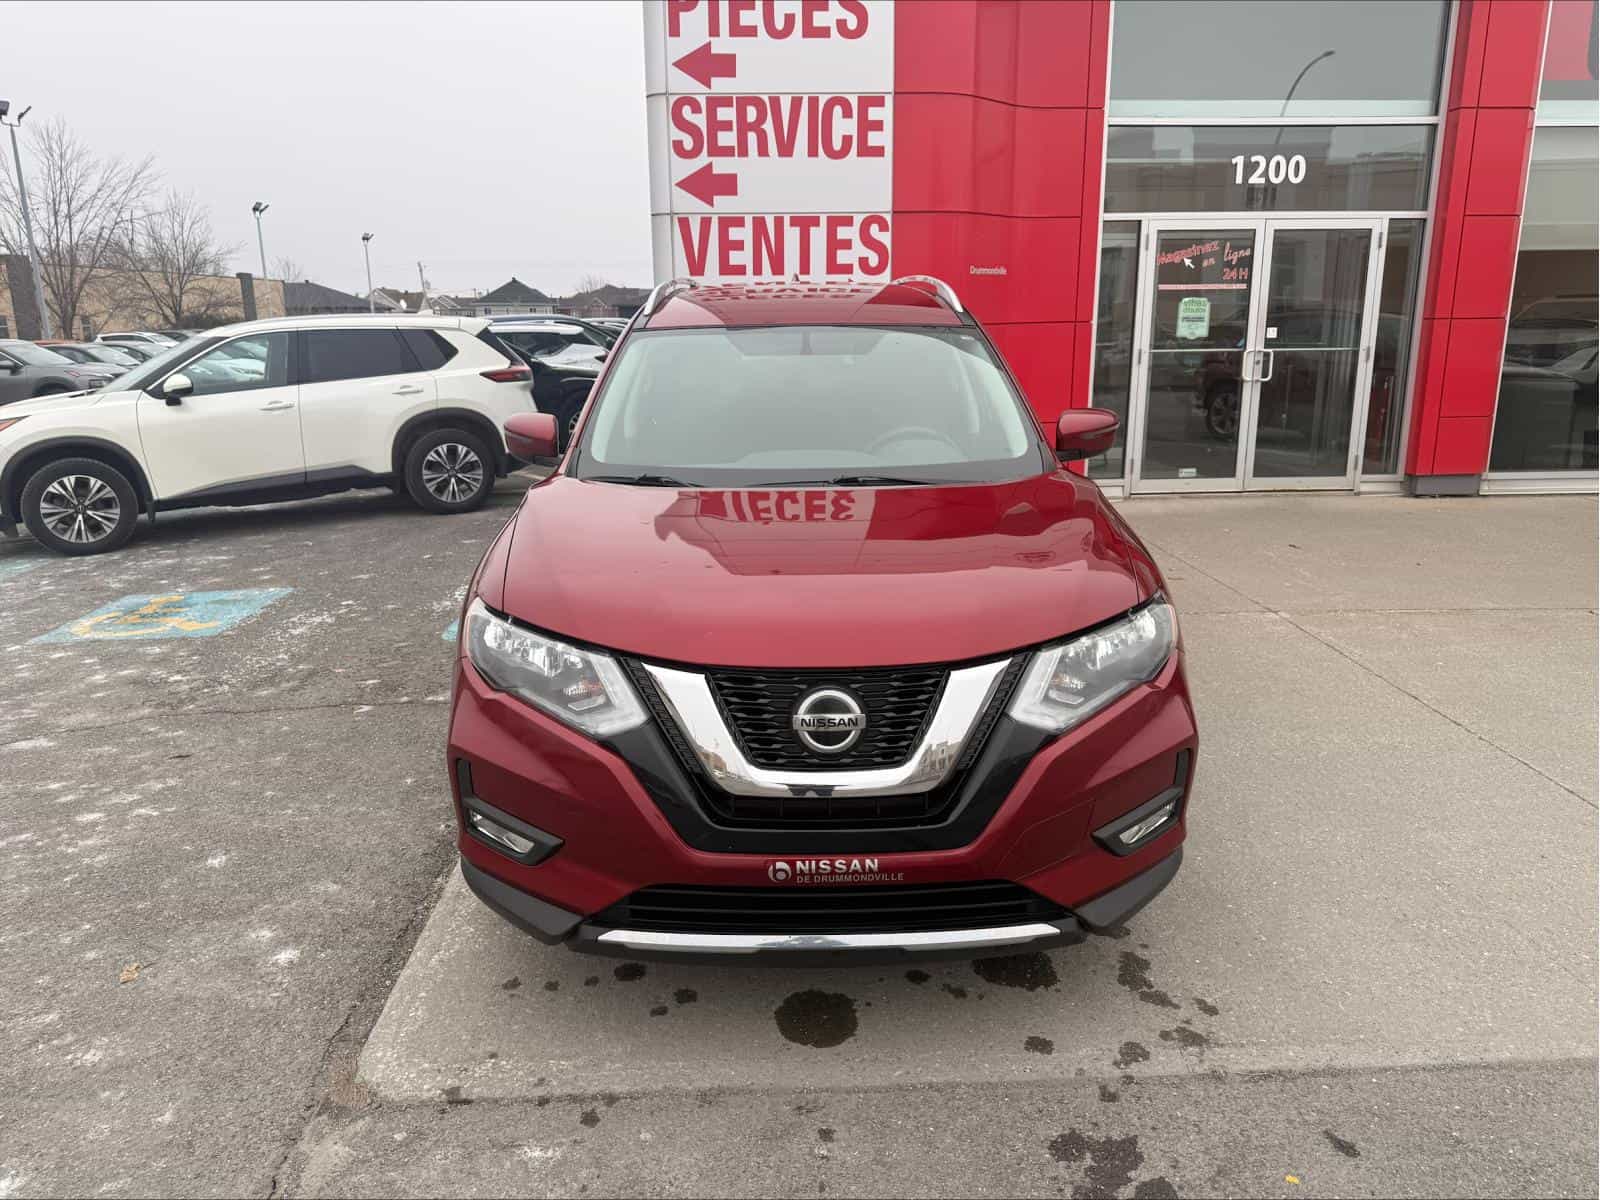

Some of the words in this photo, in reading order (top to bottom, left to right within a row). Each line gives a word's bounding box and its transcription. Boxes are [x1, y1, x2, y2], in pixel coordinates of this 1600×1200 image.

[671, 95, 886, 160] SERVICE
[1232, 154, 1306, 184] 1200
[678, 215, 890, 277] VENTES
[800, 717, 859, 728] NISSAN
[795, 858, 879, 874] NISSAN
[797, 875, 812, 884] DE
[814, 872, 905, 883] DRUMMONDVILLE
